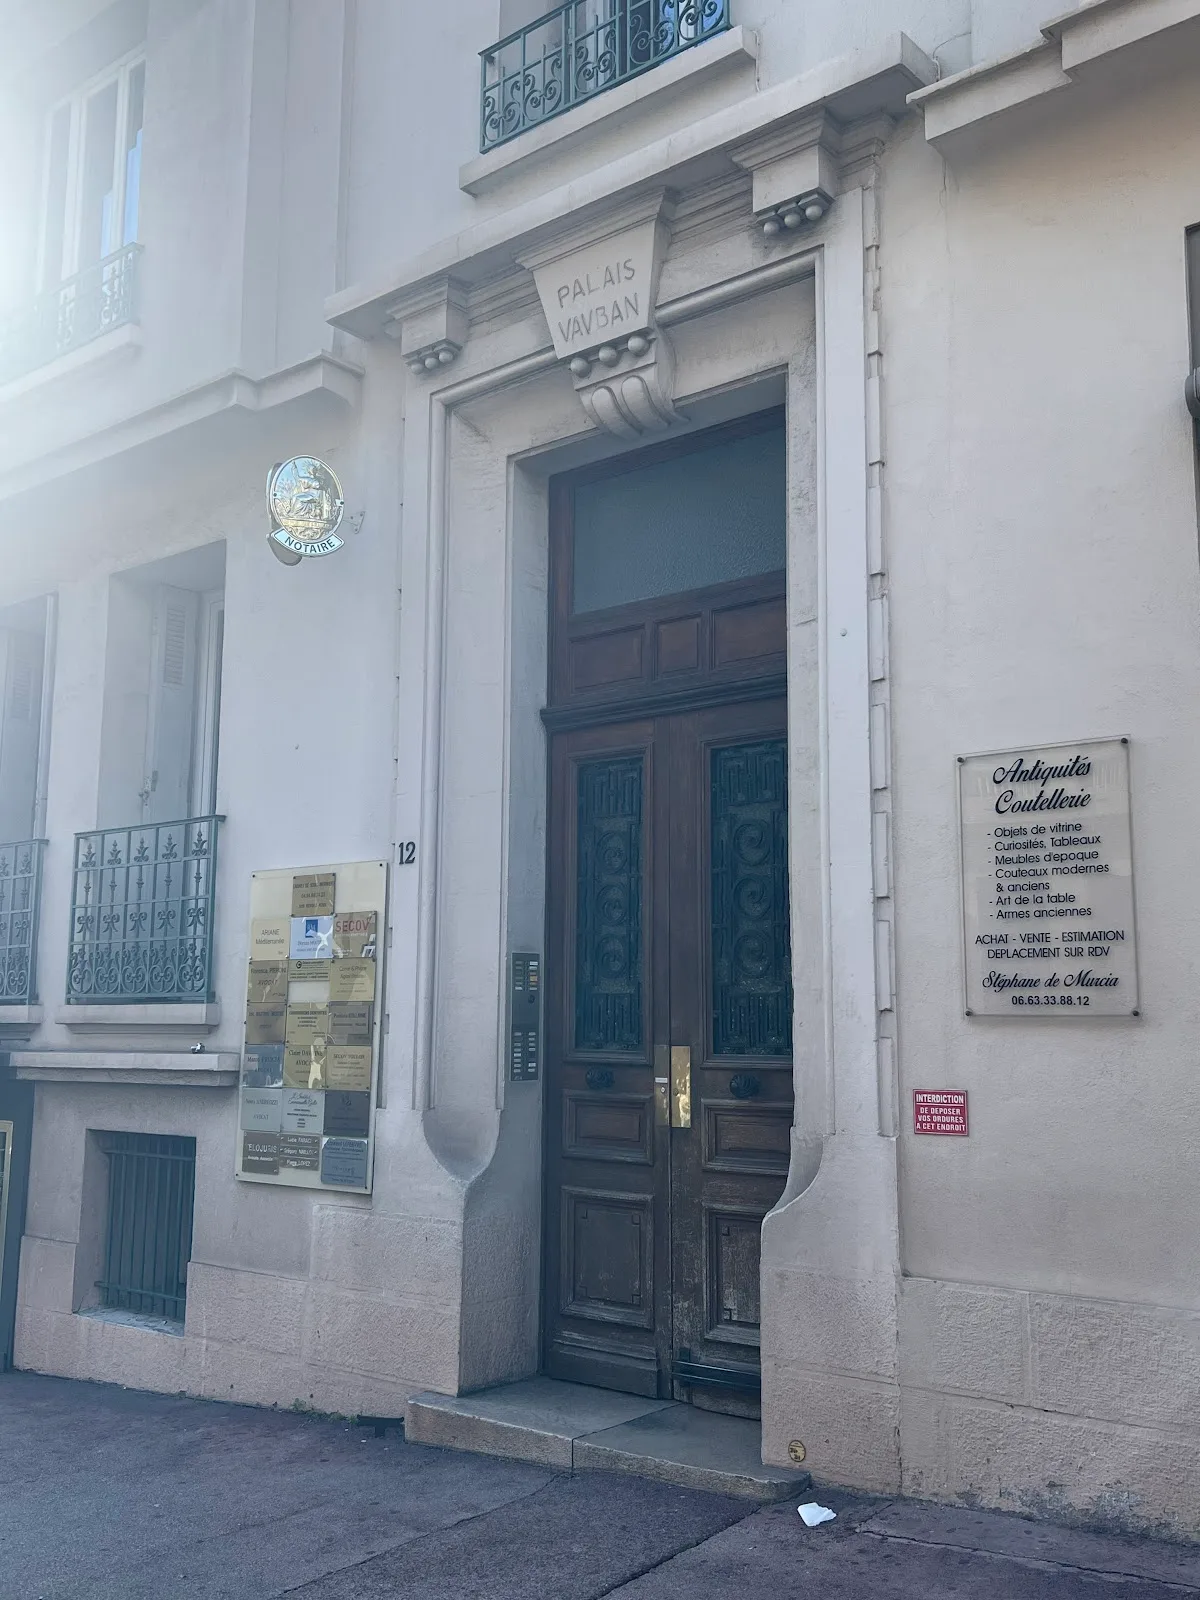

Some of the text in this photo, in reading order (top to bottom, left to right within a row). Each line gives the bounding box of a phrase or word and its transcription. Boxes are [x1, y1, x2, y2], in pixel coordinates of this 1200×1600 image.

[558, 258, 636, 308] PALAIS
[284, 536, 335, 553] NOTAIRE
[992, 756, 1091, 787] Antiquités
[994, 788, 1092, 814] Coutellerie
[994, 822, 1082, 840] Objets de vitrine
[994, 834, 1102, 852] Curiosités, Tableaux
[398, 841, 416, 865] 12
[995, 850, 1099, 866] Meubles d'epoque
[996, 863, 1109, 879] Couteaux modernes
[996, 880, 1050, 892] & anciens
[996, 892, 1076, 906] Art de la table
[996, 906, 1092, 920] Armes anciennes
[975, 930, 1125, 945] ACHAT VENTE ESTIMATION
[988, 946, 1110, 960] DEPLACEMENT SUR RDV
[982, 968, 1120, 992] Stéphane de Murcia
[1011, 995, 1090, 1006] 06.63.33.88.12
[916, 1094, 964, 1104] INTERDICTION
